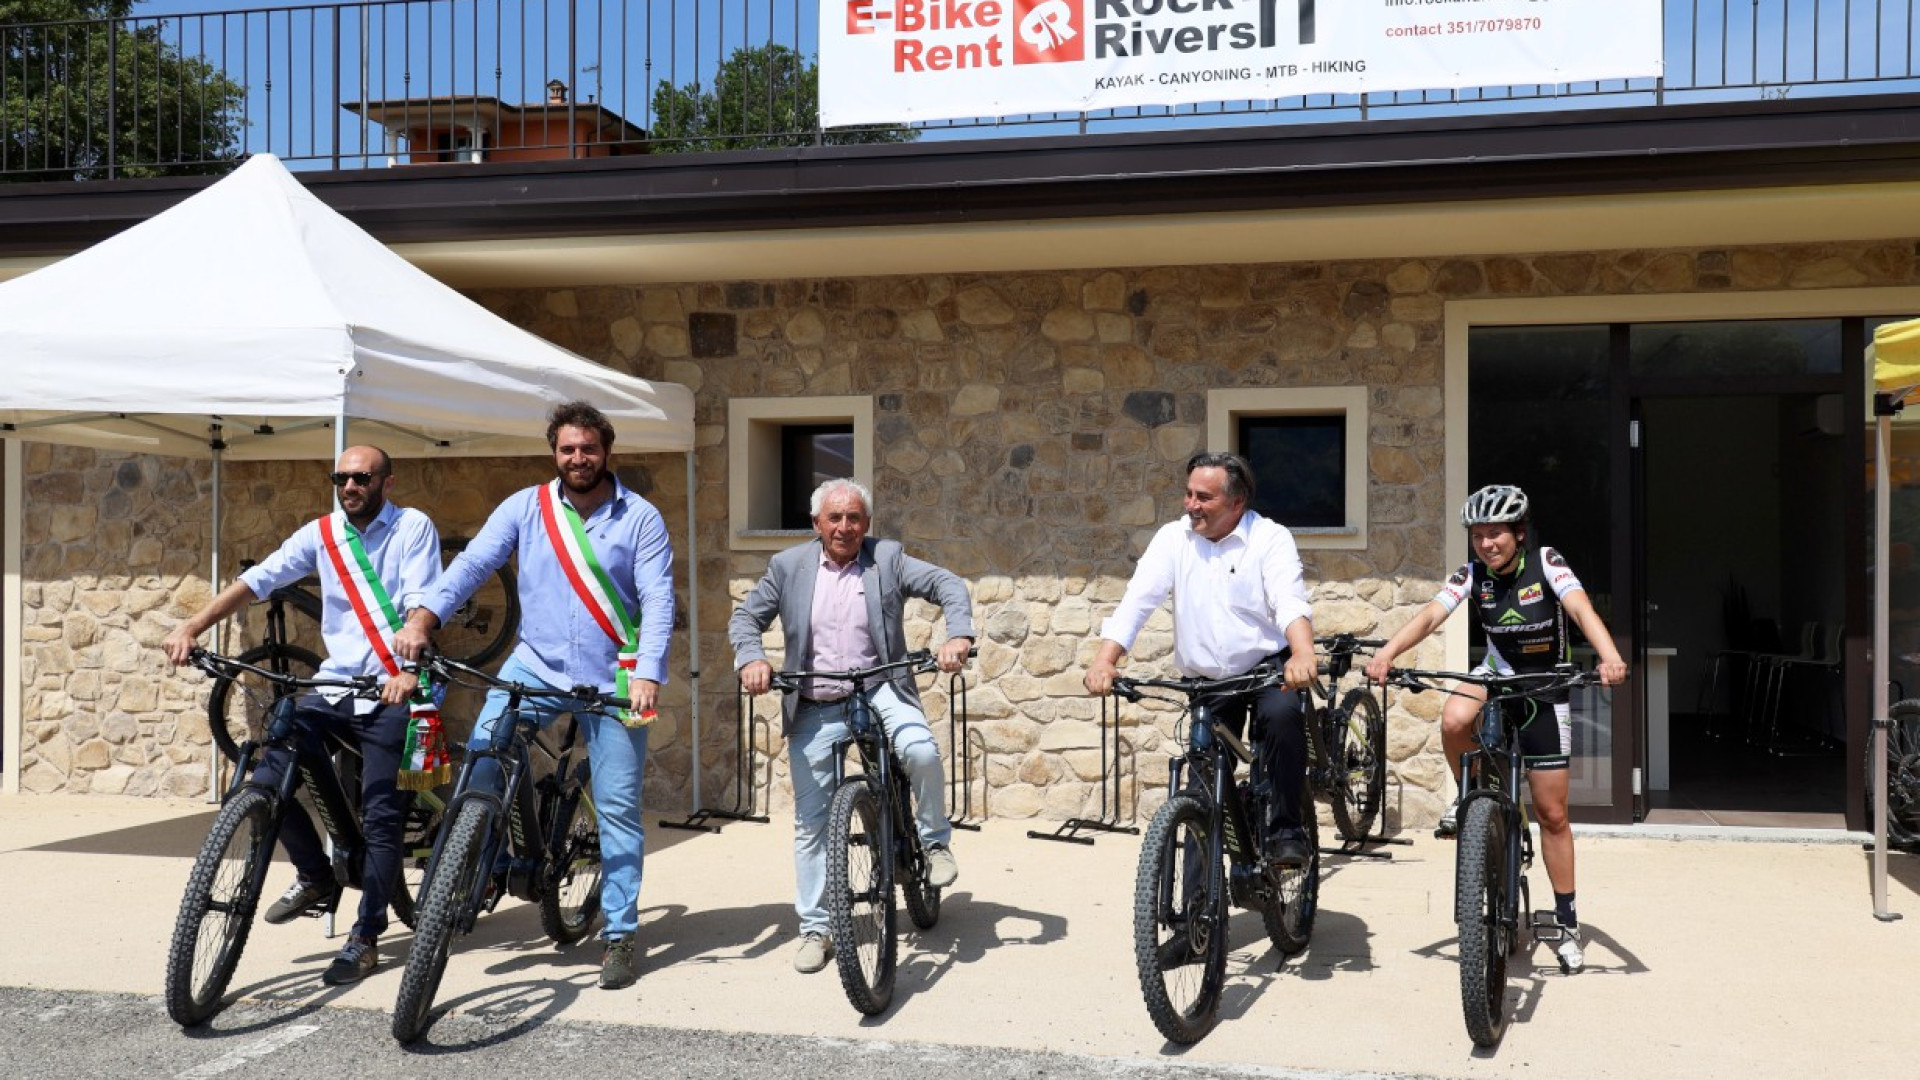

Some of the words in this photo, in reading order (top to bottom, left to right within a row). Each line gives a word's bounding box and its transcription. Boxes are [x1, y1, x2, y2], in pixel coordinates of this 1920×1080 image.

[846, 0, 1002, 34] E-Bike
[1385, 23, 1442, 37] contact
[1447, 17, 1542, 35] 351/7079870
[893, 33, 1002, 73] Rent
[1094, 21, 1257, 59] Rivers
[1094, 73, 1145, 90] KAYAK
[1158, 67, 1251, 85] CANYONING
[1266, 64, 1298, 79] MTB
[1311, 59, 1367, 74] HIKING
